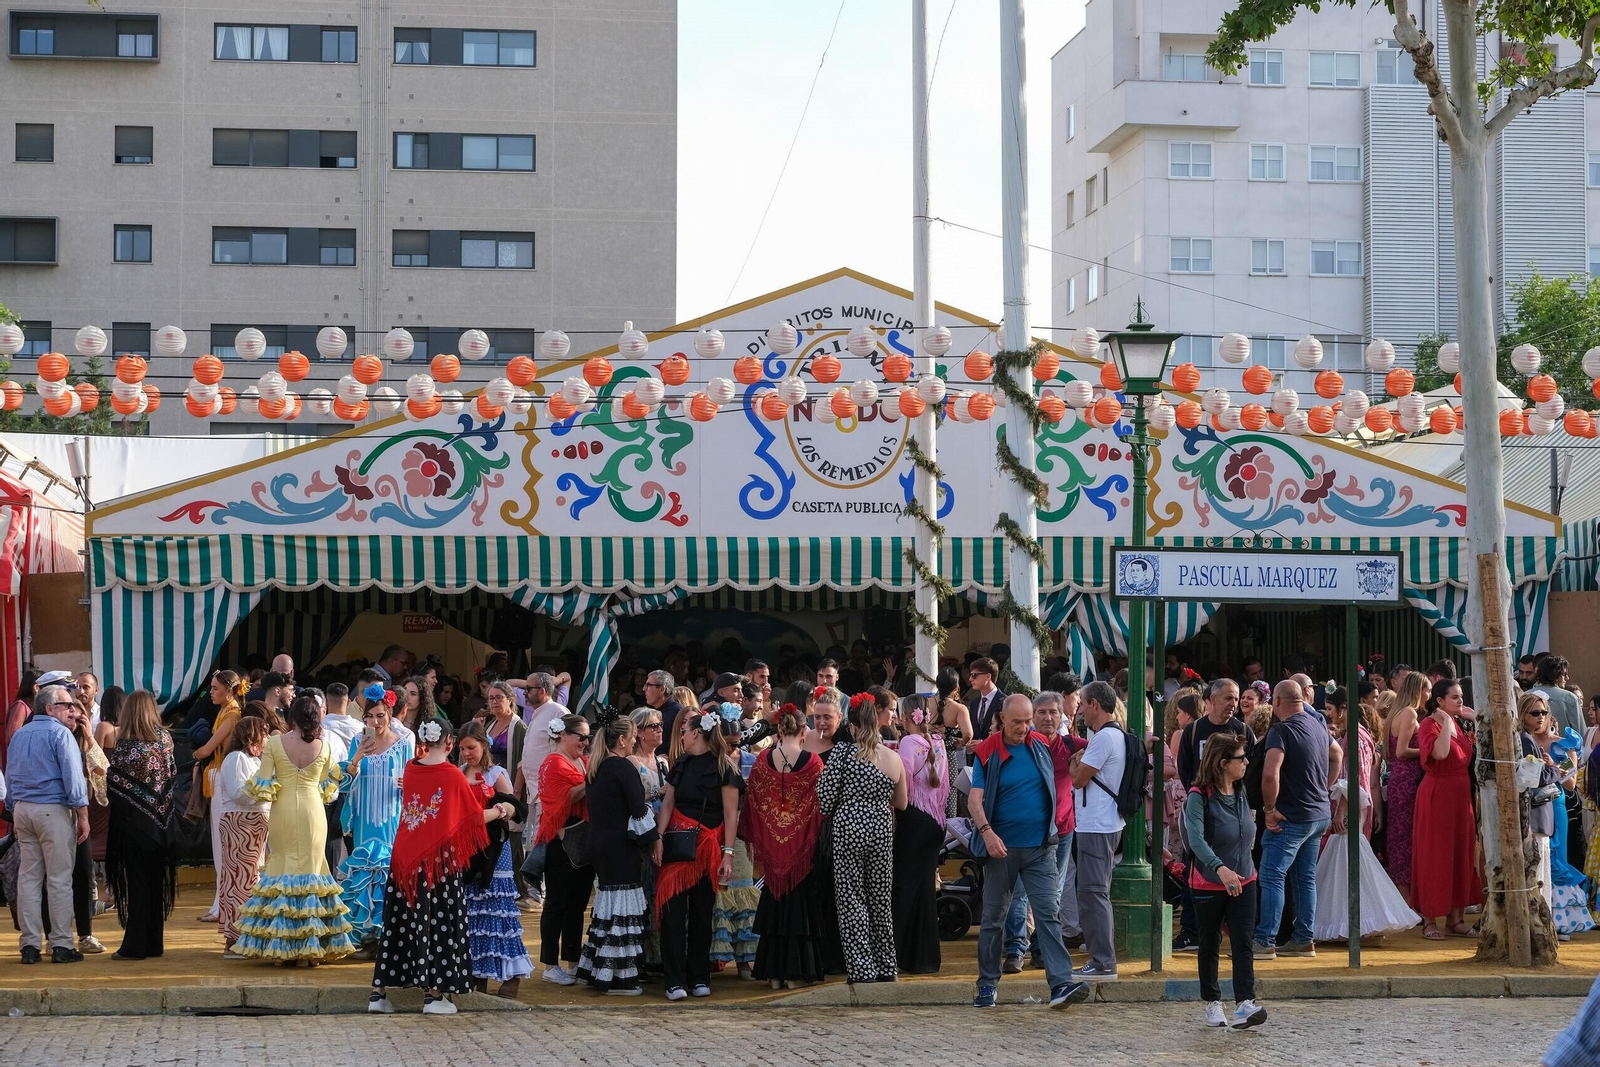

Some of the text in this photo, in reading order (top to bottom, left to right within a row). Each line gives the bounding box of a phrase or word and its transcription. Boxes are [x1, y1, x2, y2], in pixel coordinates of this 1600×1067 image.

[796, 436, 898, 481] LOS REMEDIOS
[792, 501, 902, 514] CASETA PUBLICA
[1178, 564, 1338, 592] PASCUAL MARQUEZ
[404, 615, 443, 625] REMSA
